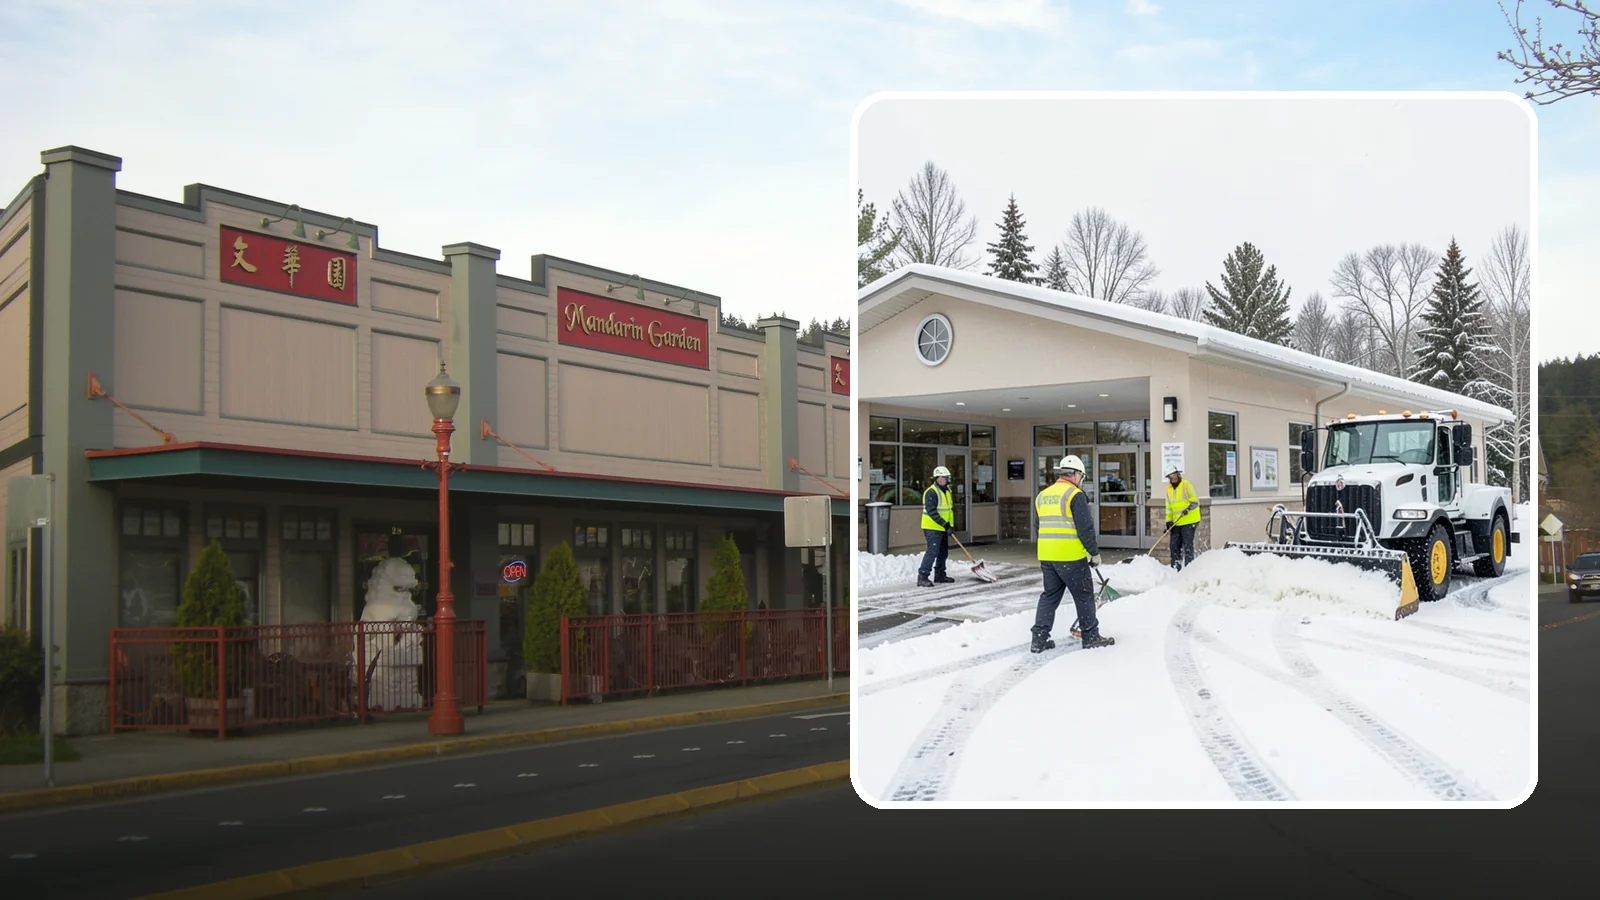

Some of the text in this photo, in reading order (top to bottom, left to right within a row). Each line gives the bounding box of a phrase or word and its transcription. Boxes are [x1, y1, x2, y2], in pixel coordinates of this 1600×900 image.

[230, 235, 346, 291] 文華園
[564, 302, 701, 352] Mandarin Garden
[503, 565, 527, 578] OPEN
